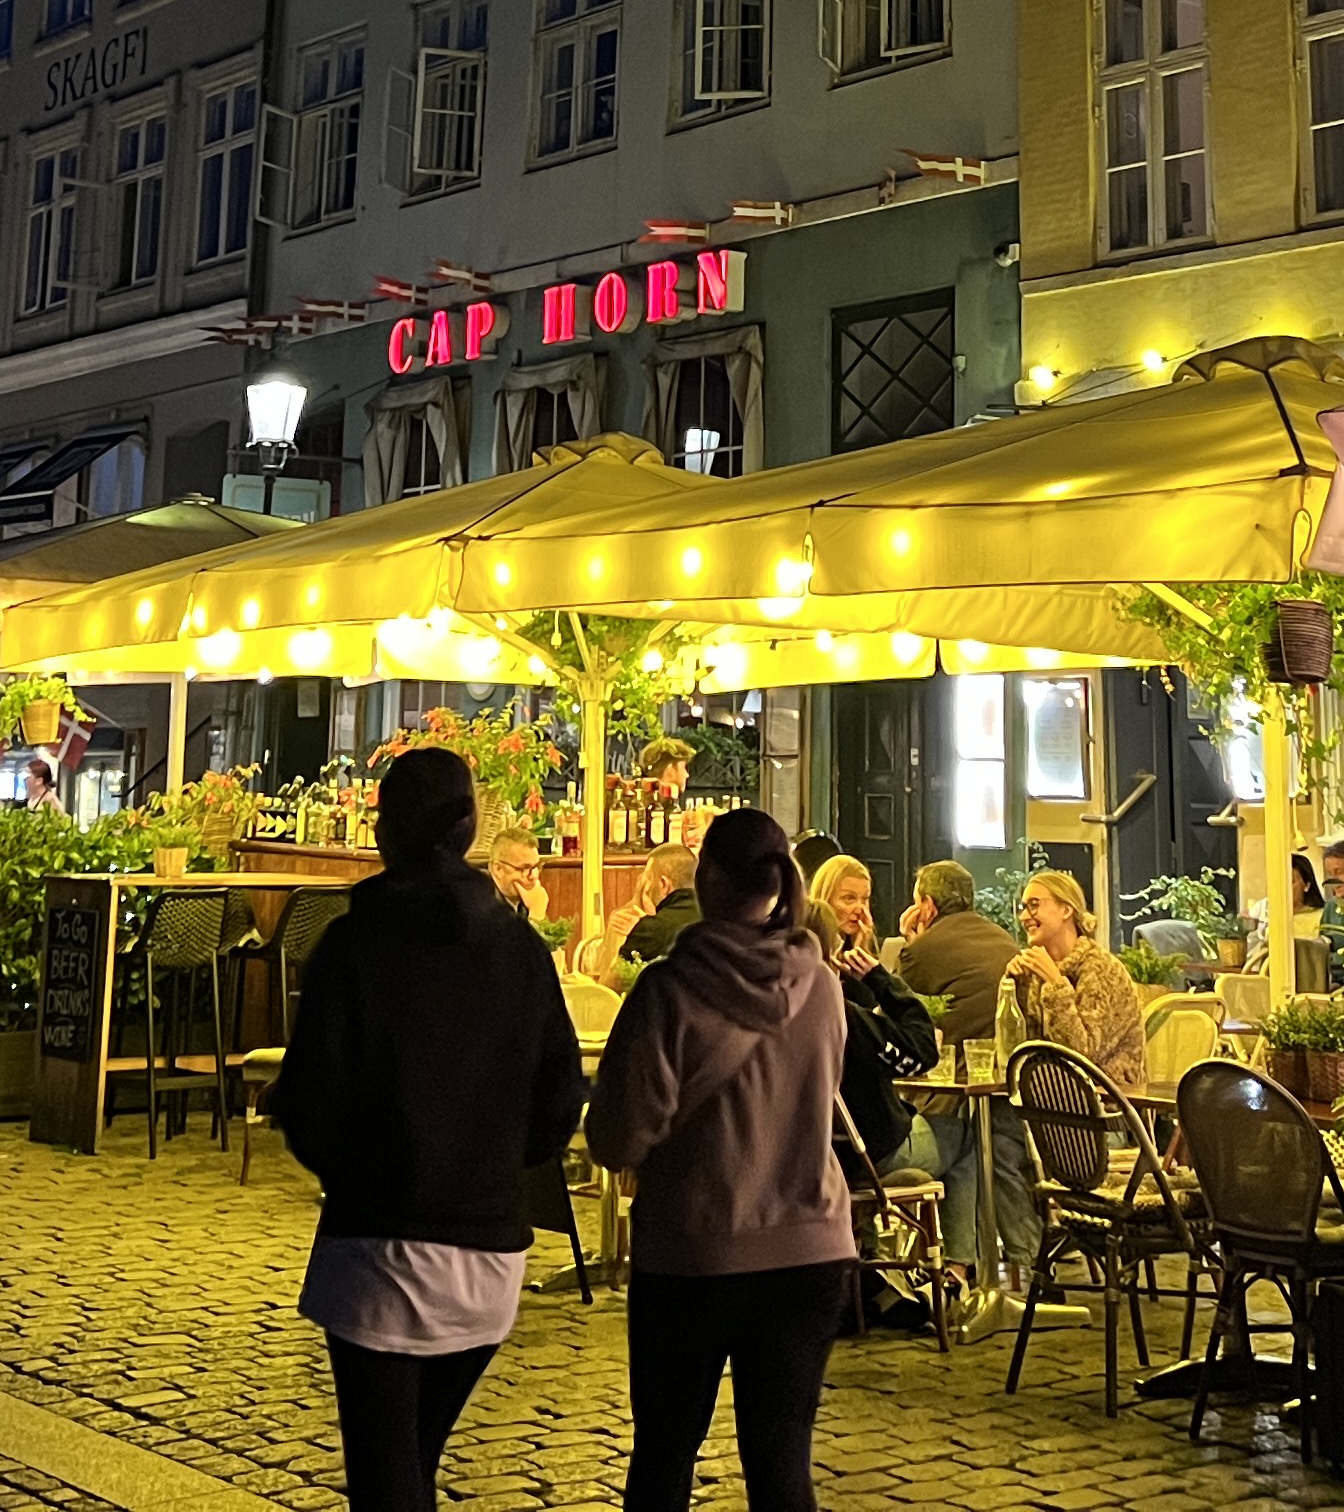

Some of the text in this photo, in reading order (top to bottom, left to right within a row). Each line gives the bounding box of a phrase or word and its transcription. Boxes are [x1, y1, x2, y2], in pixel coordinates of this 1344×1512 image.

[44, 26, 148, 112] SKAGFI
[388, 250, 732, 374] CAP HORN
[71, 913, 89, 945] Go
[50, 949, 89, 987] BEER
[46, 989, 90, 1017] DRINKS
